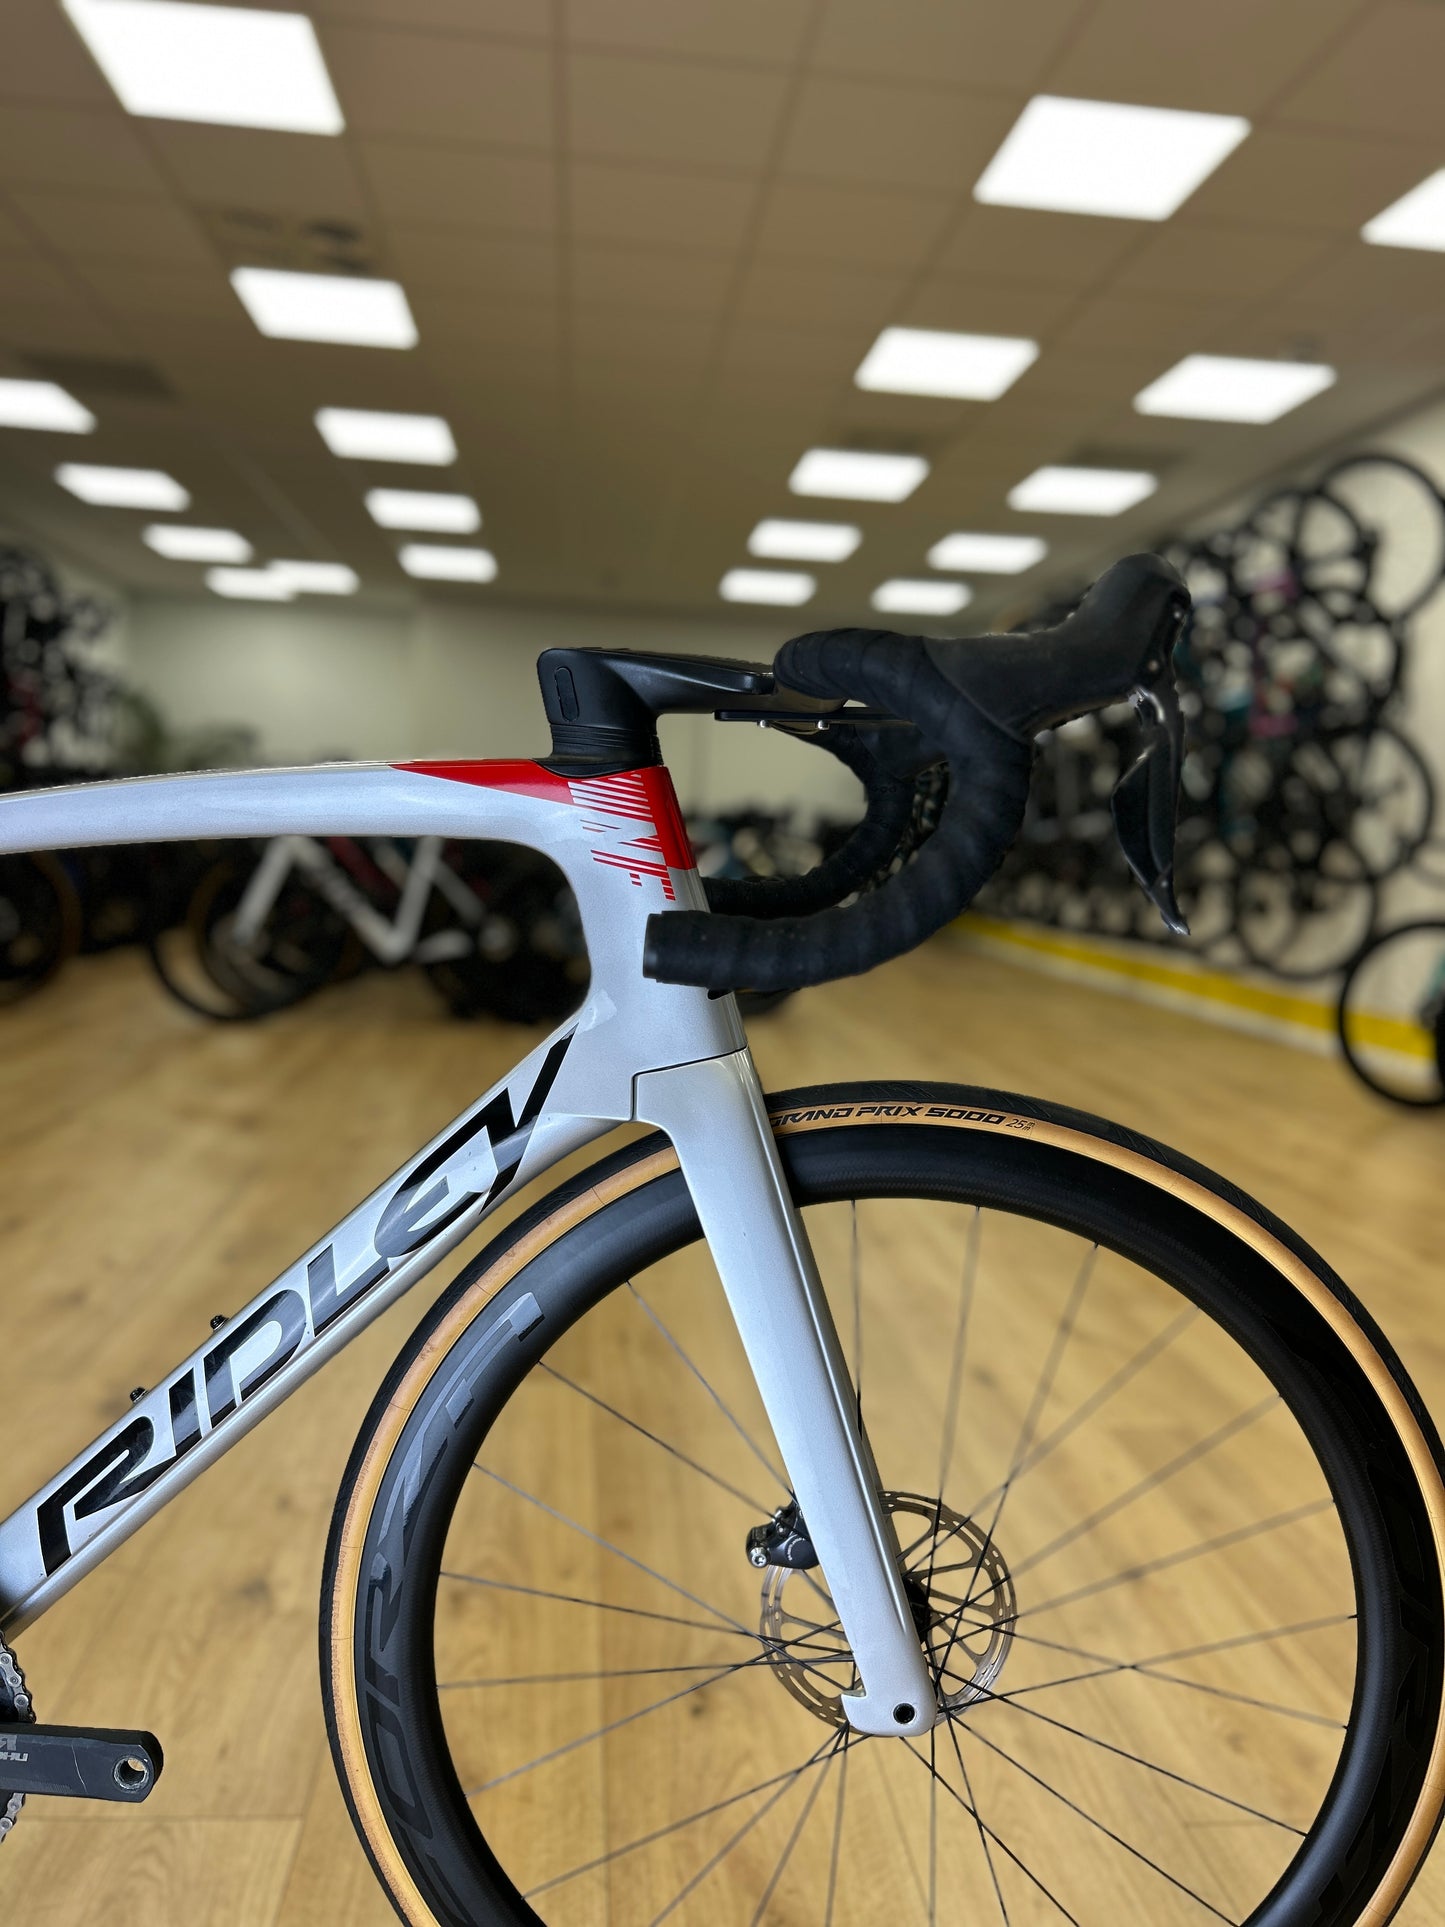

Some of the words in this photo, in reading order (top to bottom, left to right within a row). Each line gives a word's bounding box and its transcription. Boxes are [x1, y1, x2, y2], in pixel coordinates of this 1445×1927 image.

[769, 1107, 855, 1127] GRAND
[855, 1105, 924, 1118] PRIX
[924, 1106, 1007, 1126] 5000
[37, 1023, 579, 1577] RIDLEY
